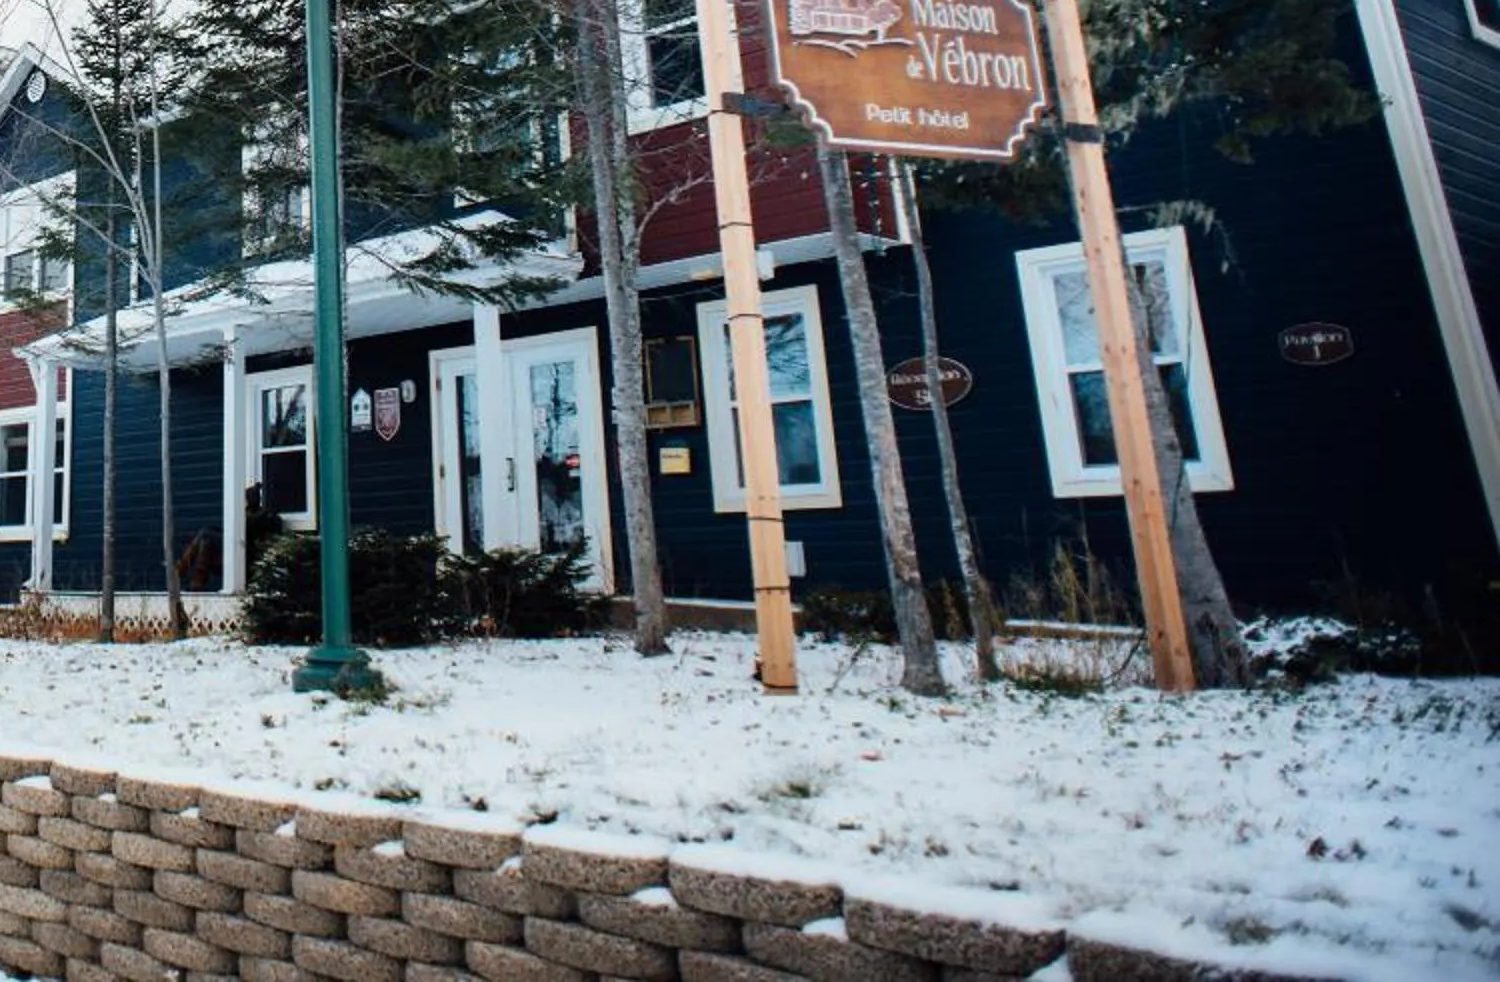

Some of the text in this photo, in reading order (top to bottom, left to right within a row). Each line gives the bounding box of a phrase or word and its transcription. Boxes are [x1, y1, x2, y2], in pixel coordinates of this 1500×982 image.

[906, 31, 1032, 91] de Vébron
[864, 102, 969, 130] Petit hôtel
